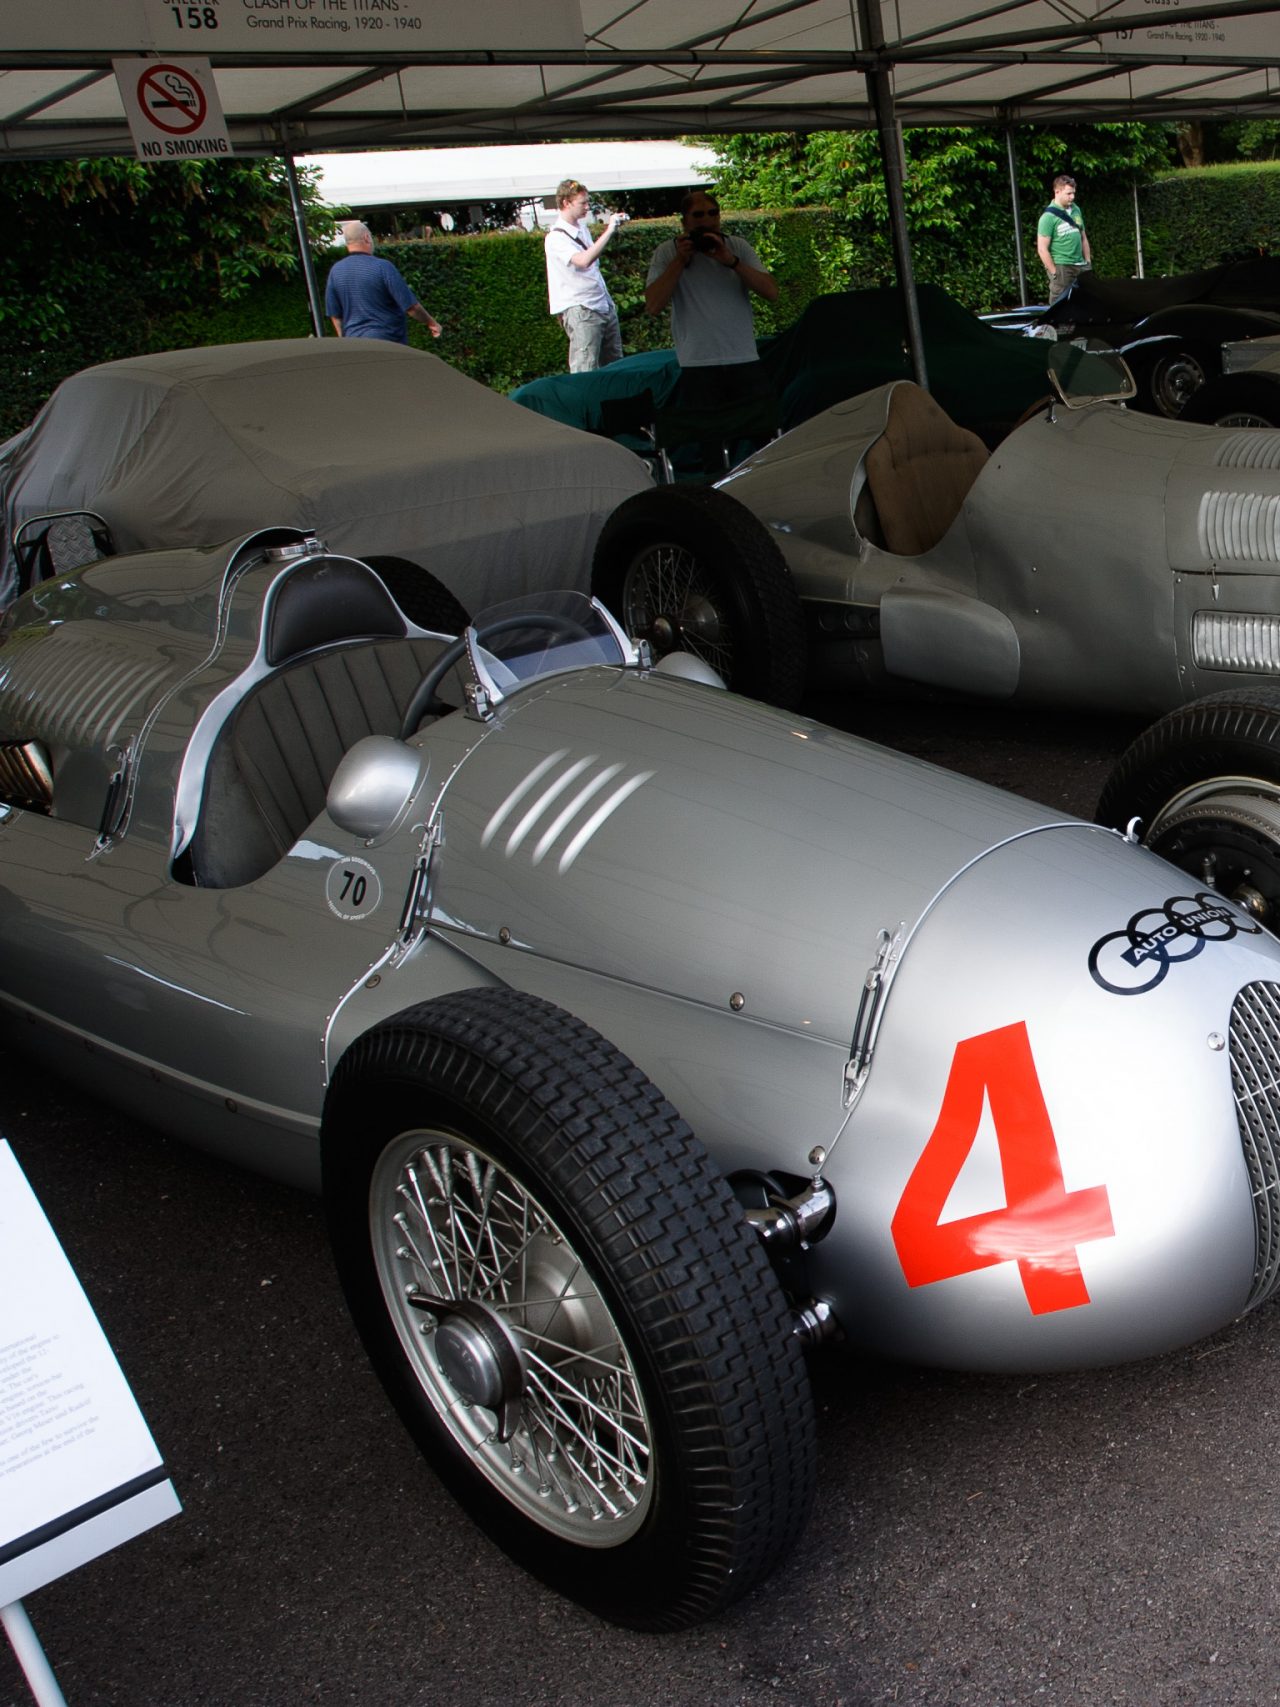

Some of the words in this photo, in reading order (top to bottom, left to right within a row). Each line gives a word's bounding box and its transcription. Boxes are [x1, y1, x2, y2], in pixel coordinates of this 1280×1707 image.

[171, 6, 219, 29] 158
[246, 15, 285, 28] Grand
[288, 15, 308, 29] Prix
[311, 16, 351, 32] Racing,
[355, 17, 383, 29] 1920
[394, 17, 422, 30] 1940
[141, 142, 163, 157] NO
[164, 138, 229, 155] SMOKING
[340, 870, 367, 906] 70
[1132, 926, 1178, 962] AUTO
[1180, 907, 1229, 927] UNION
[890, 1020, 1115, 1316] 4
